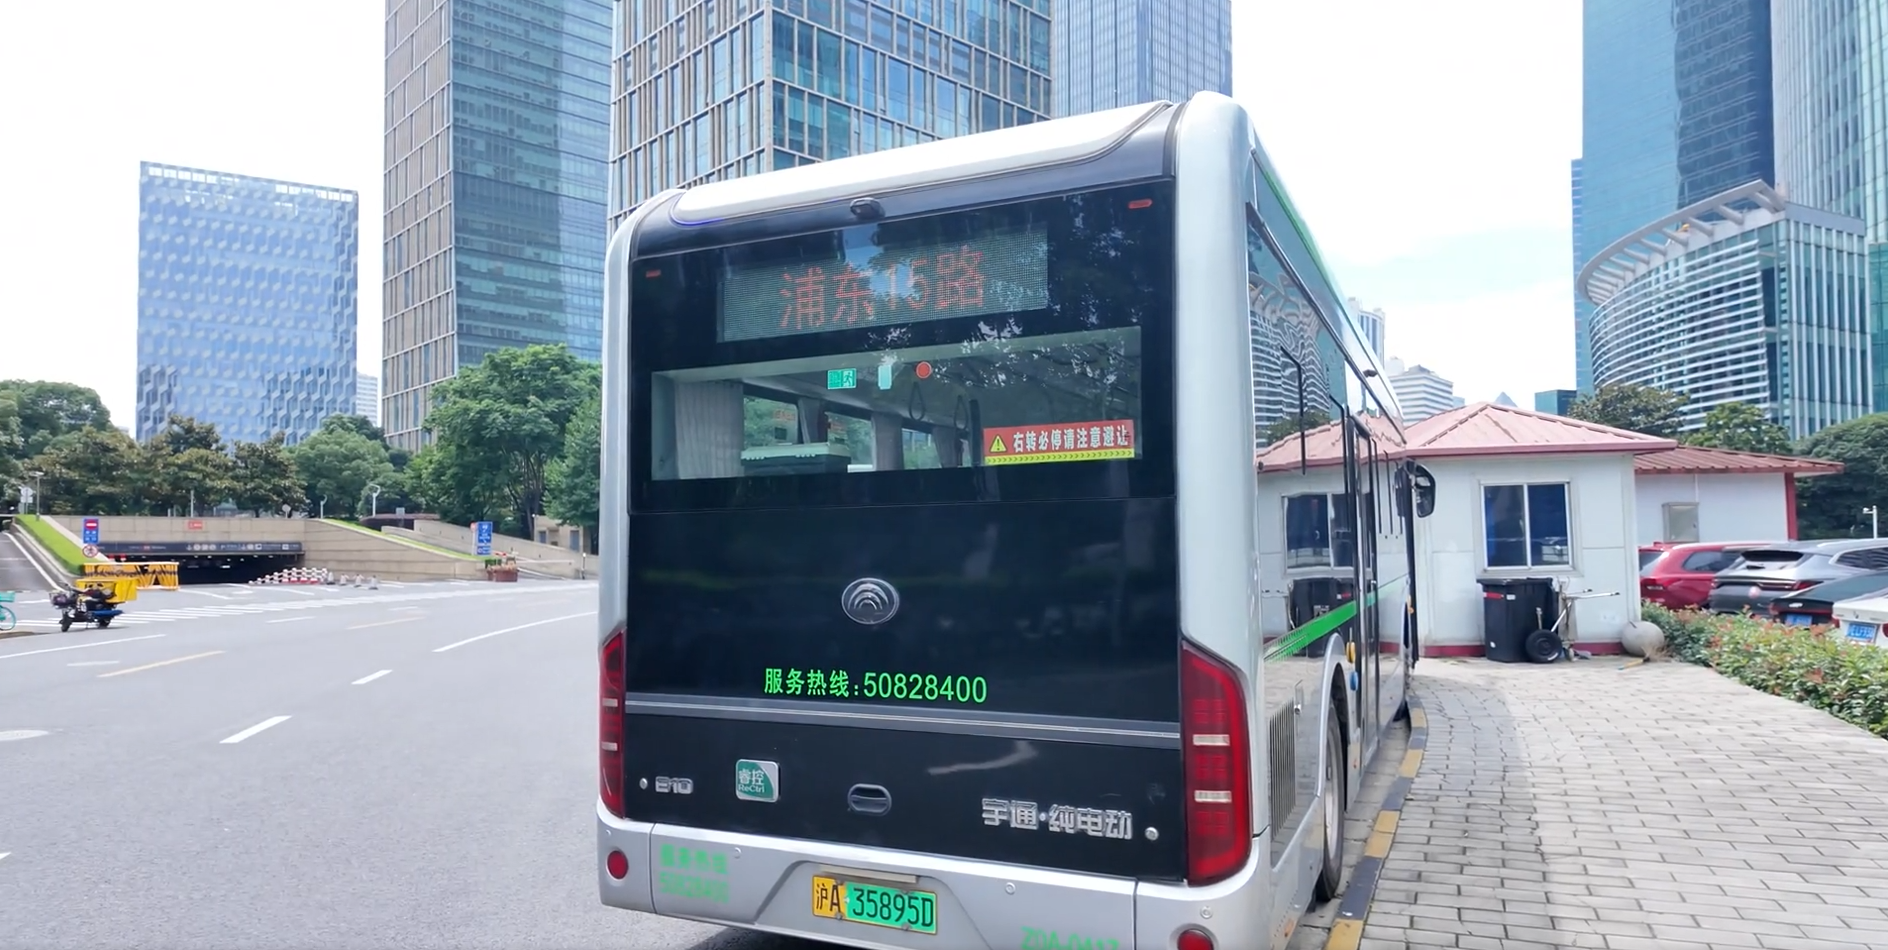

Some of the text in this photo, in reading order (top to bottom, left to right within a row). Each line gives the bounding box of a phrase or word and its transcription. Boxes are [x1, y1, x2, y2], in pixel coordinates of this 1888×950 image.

[779, 245, 984, 330] 浦东15路
[1013, 425, 1130, 453] 右转必停请注意避让
[655, 776, 694, 795] E10
[738, 768, 765, 786] 睿控
